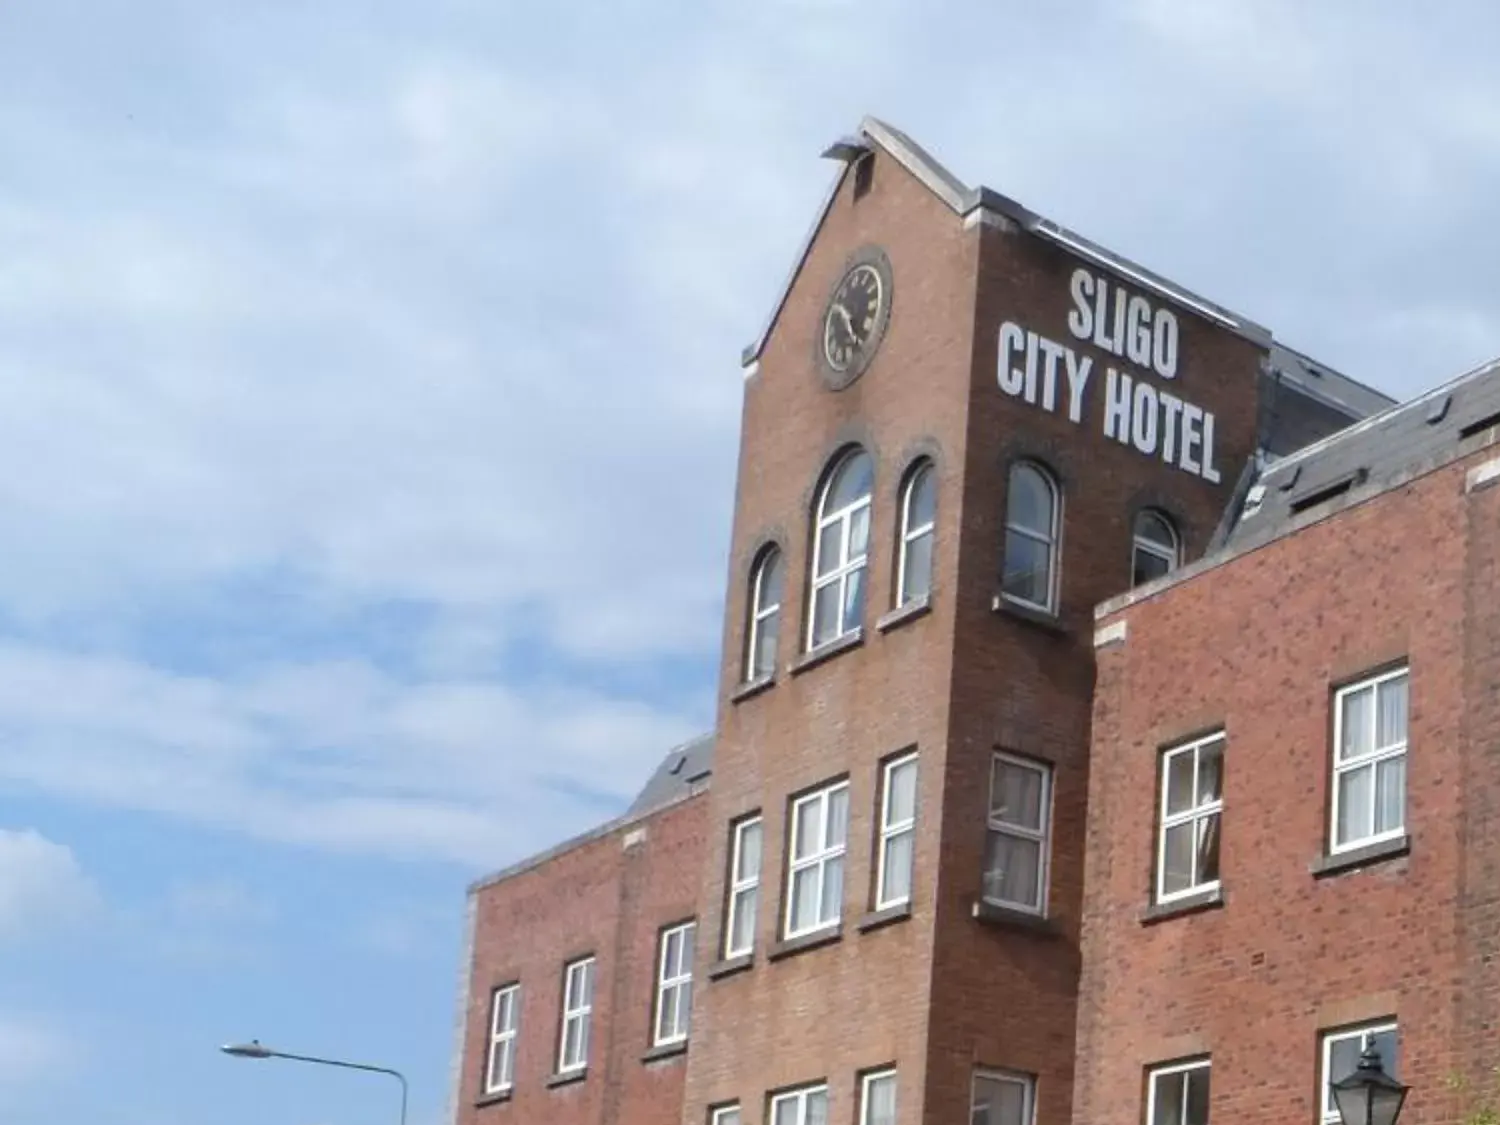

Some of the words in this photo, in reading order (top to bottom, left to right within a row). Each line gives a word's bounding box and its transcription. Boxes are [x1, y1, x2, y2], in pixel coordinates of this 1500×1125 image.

[1067, 268, 1179, 380] SLIGO
[996, 320, 1094, 424] CITY
[1102, 367, 1221, 485] HOTEL
